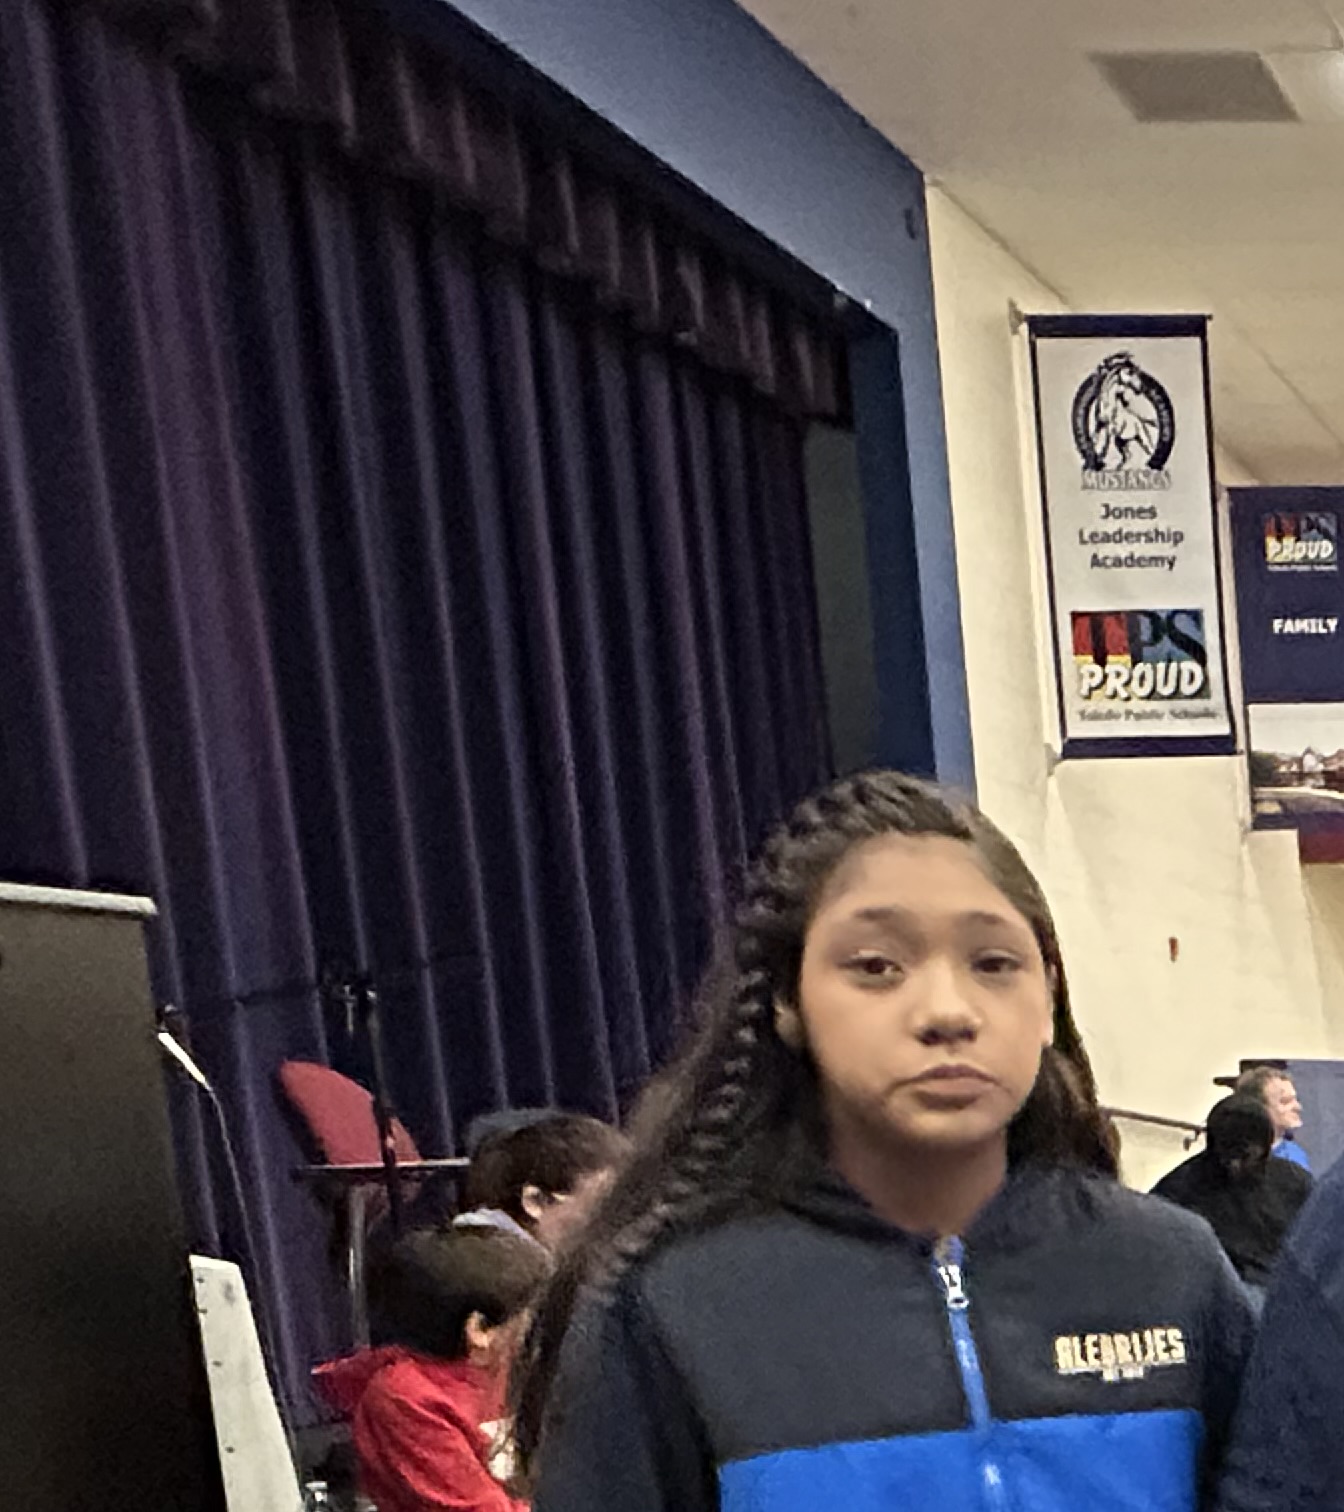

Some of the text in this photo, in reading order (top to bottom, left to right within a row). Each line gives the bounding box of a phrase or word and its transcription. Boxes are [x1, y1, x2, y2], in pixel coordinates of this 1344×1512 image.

[1100, 503, 1157, 521] Jones
[1078, 528, 1184, 548] Leadership
[1266, 538, 1334, 562] PROUD
[1090, 552, 1177, 572] Academy
[1272, 618, 1338, 634] FAMILY
[1071, 610, 1208, 669] TPS
[1079, 660, 1205, 701] PROUD
